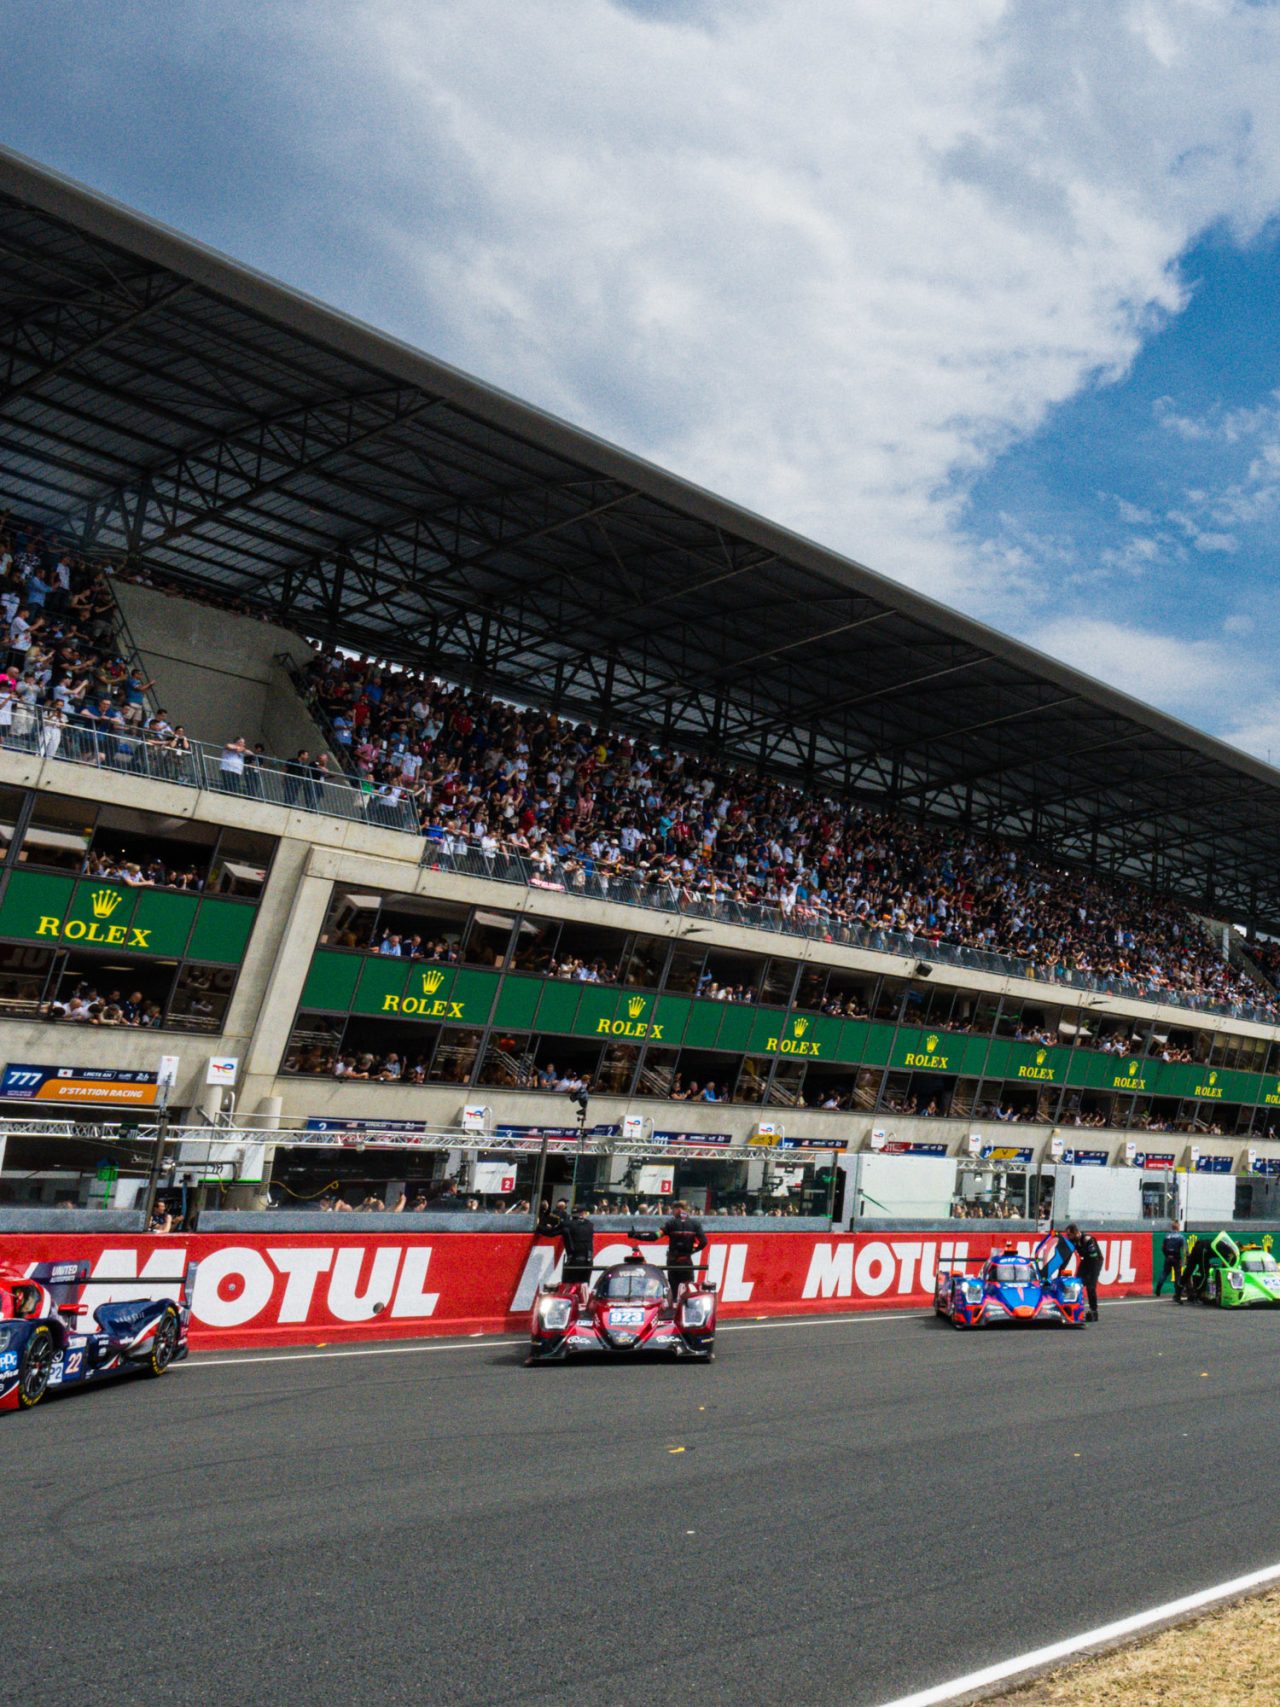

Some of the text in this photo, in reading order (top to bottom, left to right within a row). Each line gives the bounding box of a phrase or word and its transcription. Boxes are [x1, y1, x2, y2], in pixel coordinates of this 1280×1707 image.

[36, 916, 151, 947] ROLEX
[382, 994, 465, 1018] ROLEX
[596, 1018, 664, 1039] ROLEX
[766, 1038, 821, 1056] ROLEX
[905, 1053, 948, 1069] ROLEX
[8, 1071, 43, 1086] 777
[1018, 1065, 1055, 1080] ROLEX
[1113, 1076, 1146, 1090] ROLEX
[58, 1086, 144, 1098] D'STATION RACING
[1194, 1085, 1223, 1098] ROLEX
[51, 1264, 78, 1276] UNITED
[801, 1241, 975, 1299] MOTUL
[75, 1246, 440, 1333] MOTUL
[610, 1312, 643, 1322] 923
[64, 1352, 82, 1374] 22
